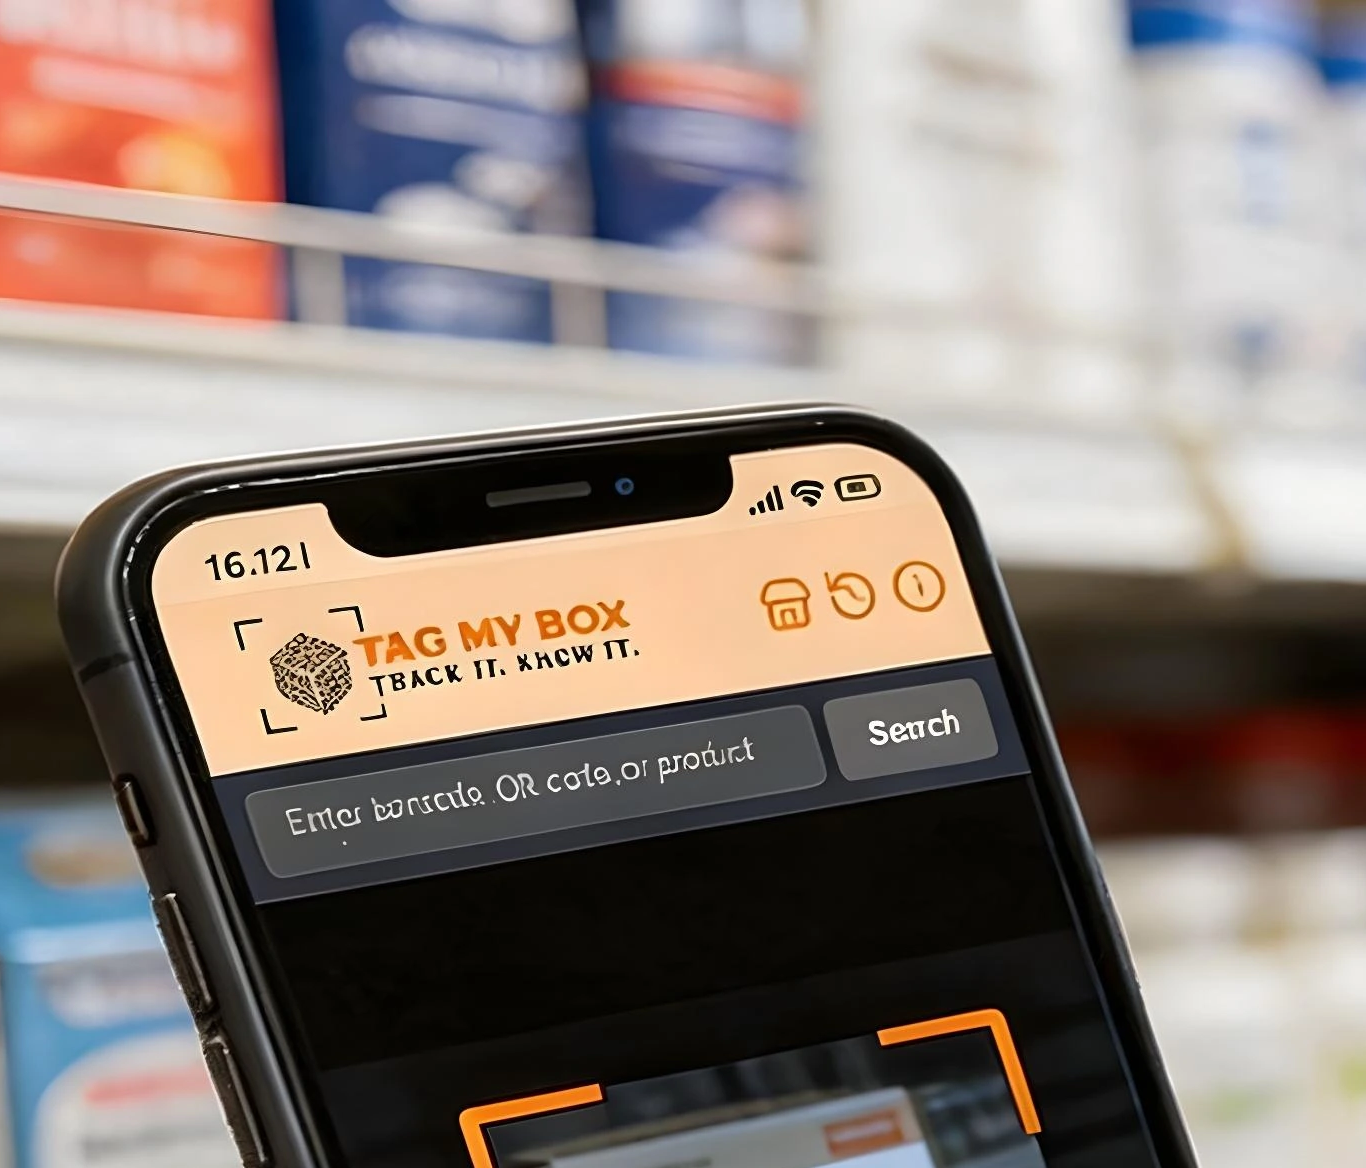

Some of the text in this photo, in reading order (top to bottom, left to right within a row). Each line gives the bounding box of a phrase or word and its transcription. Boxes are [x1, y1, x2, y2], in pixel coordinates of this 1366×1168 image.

[352, 599, 632, 668] TAG MY BOX
